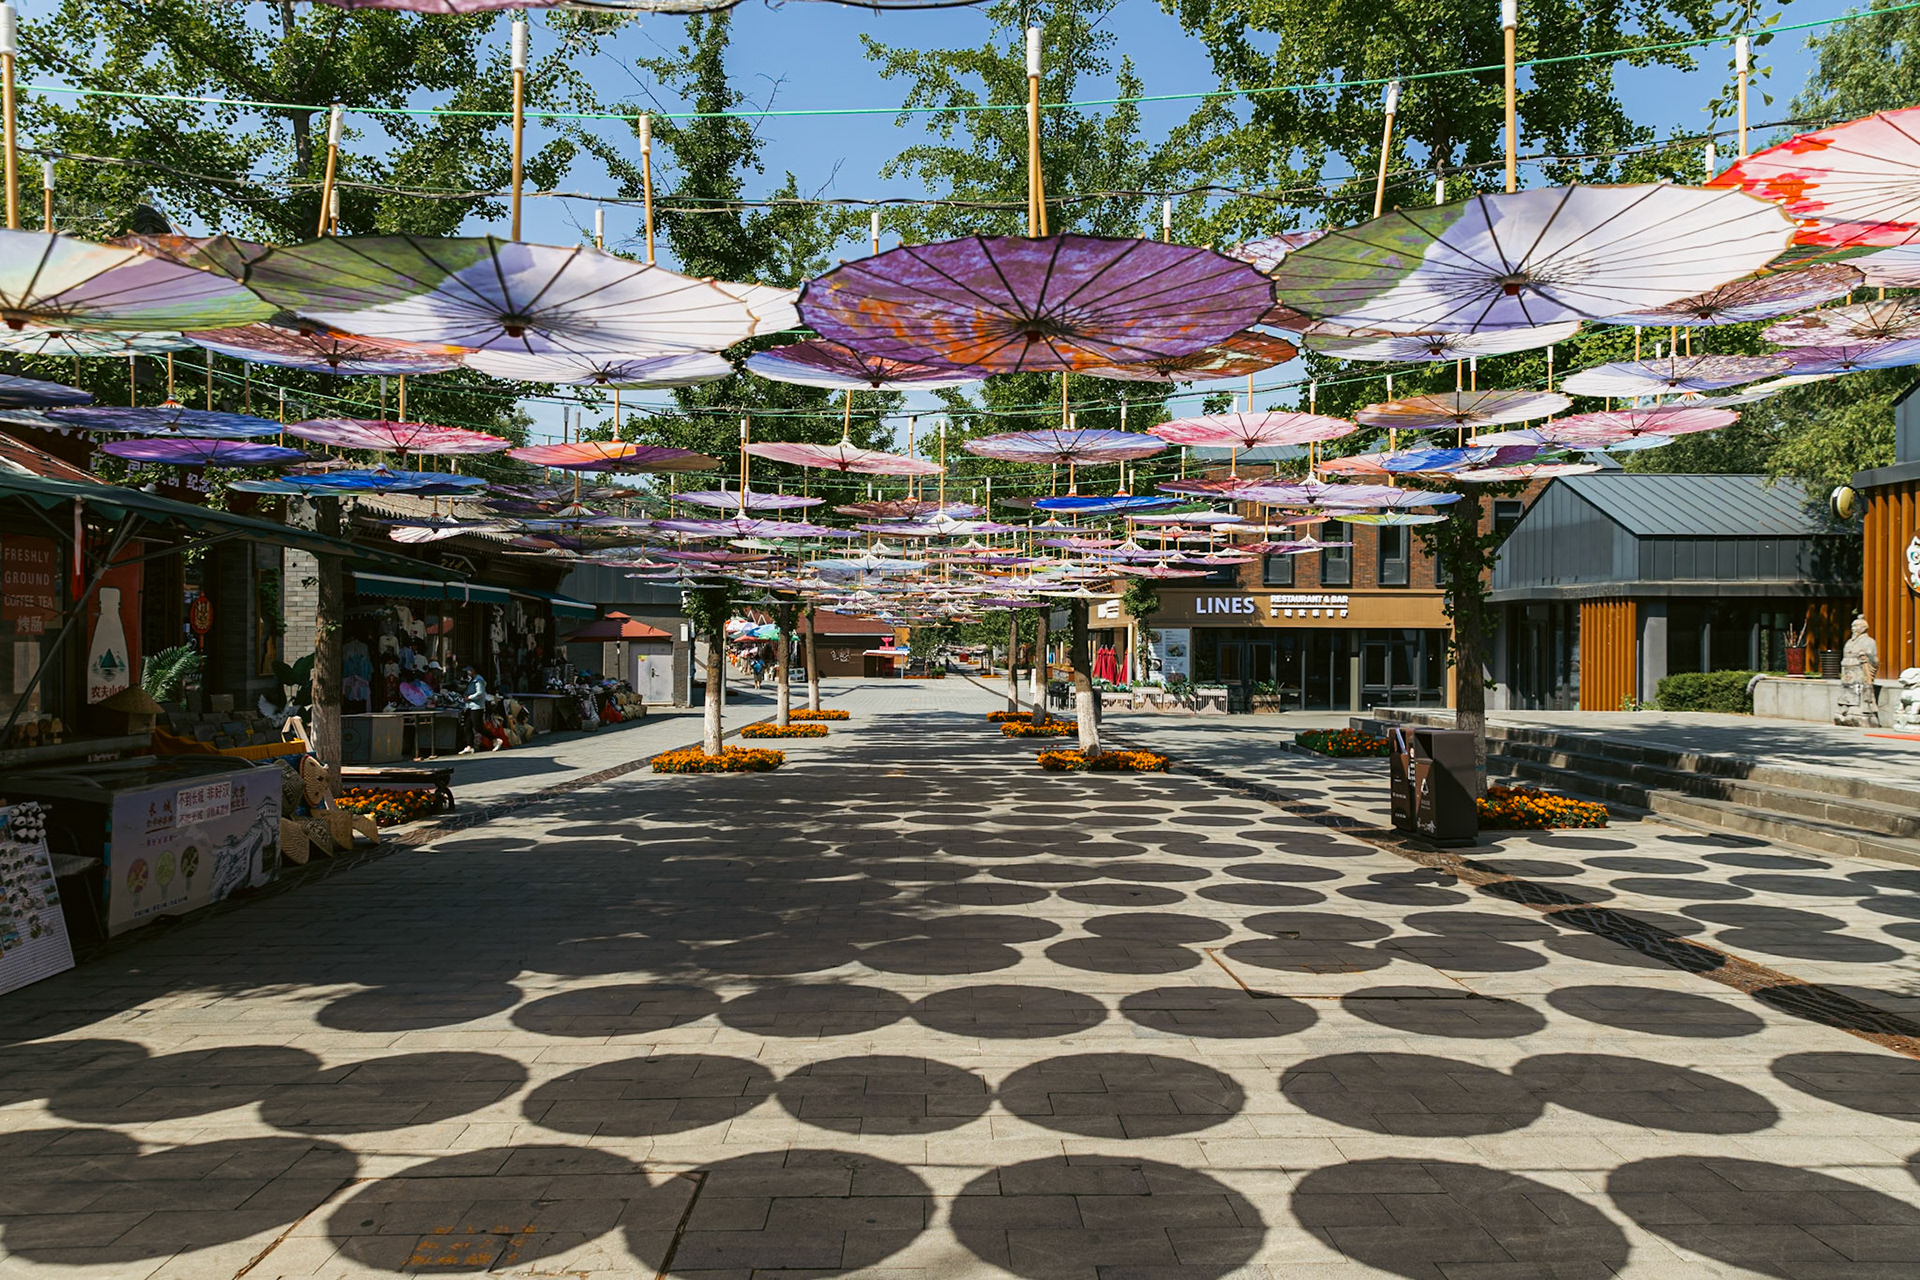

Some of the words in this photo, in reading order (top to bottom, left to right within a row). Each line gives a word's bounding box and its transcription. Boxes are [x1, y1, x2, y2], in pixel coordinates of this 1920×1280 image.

[4, 547, 50, 564] FRESHLY
[4, 571, 50, 586] GROUND
[4, 594, 35, 608] COFFEE
[38, 595, 54, 609] TEA
[1196, 597, 1255, 614] LINES
[1270, 594, 1323, 603] RESTAURANT
[1331, 595, 1349, 603] BAR
[16, 614, 42, 634] 烤肠
[206, 783, 230, 800] 非好汉
